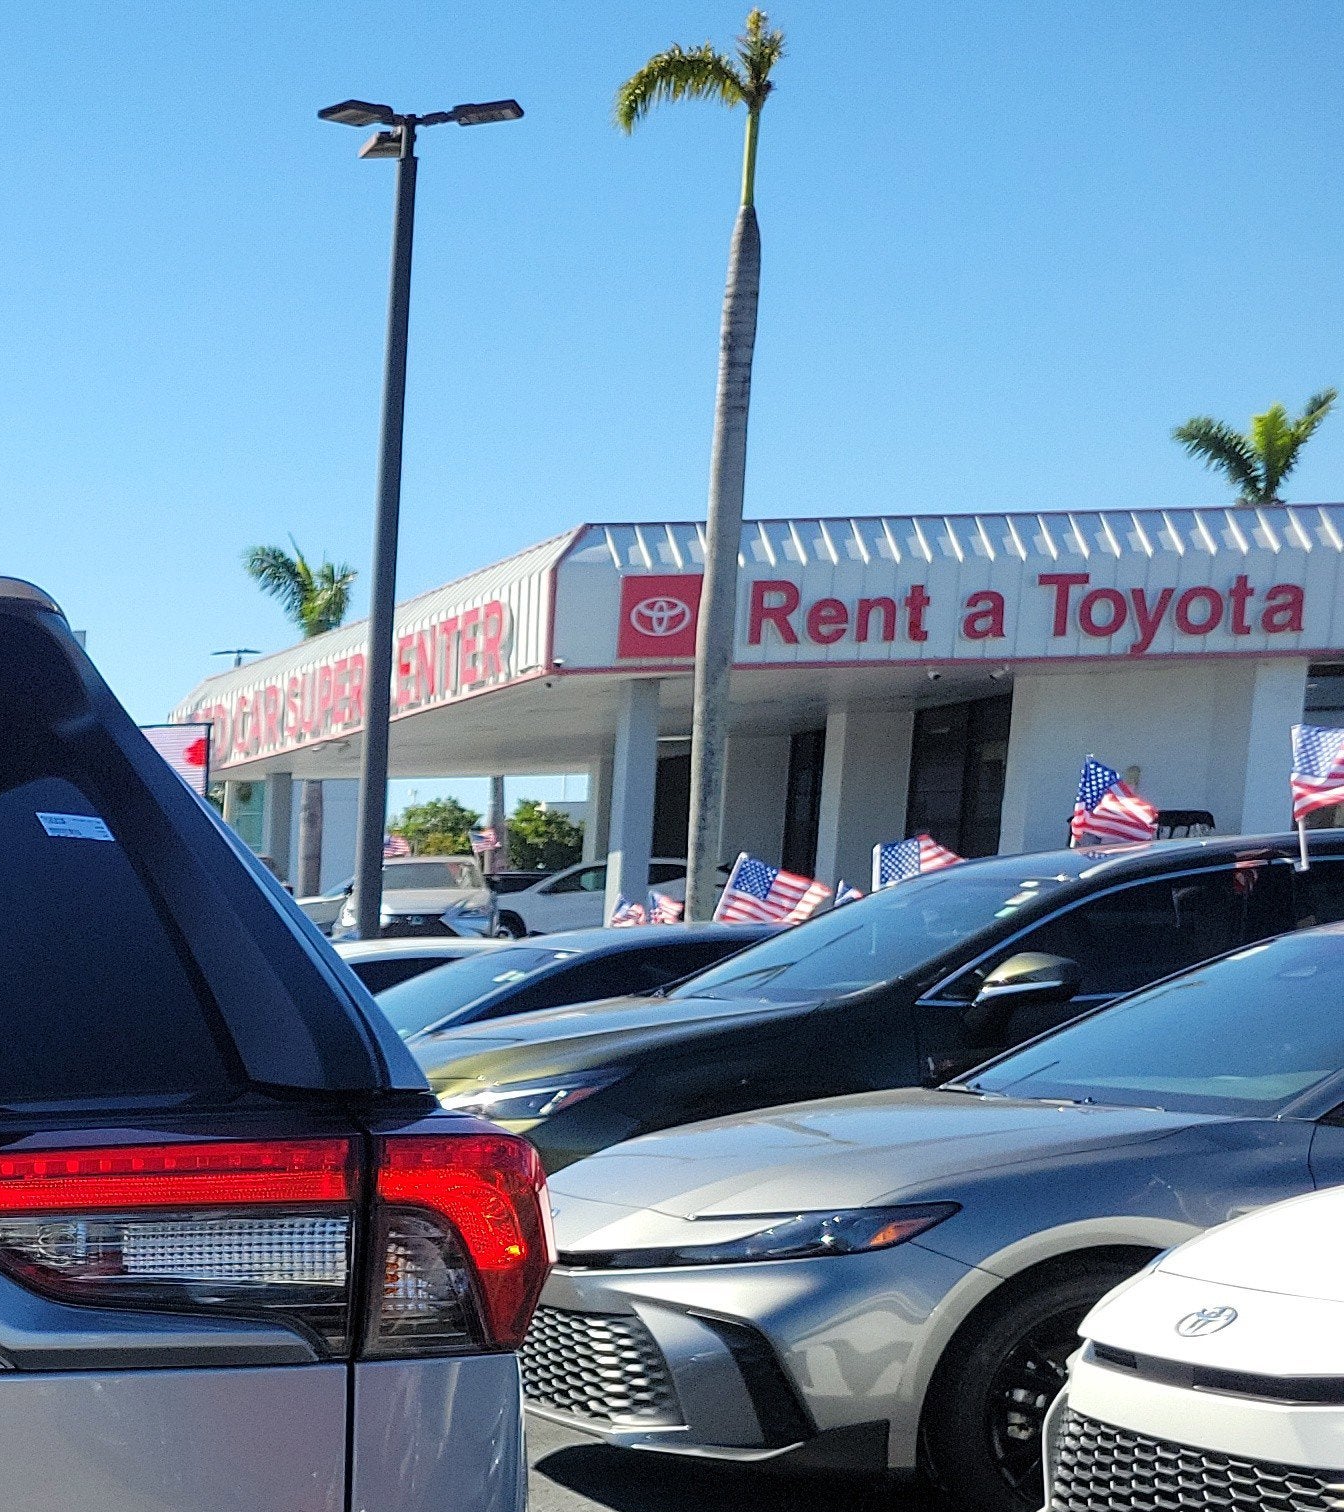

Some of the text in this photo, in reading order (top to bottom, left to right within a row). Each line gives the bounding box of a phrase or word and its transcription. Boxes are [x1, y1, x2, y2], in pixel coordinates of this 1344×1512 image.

[747, 572, 1305, 655] Rent a Toyota
[231, 684, 282, 752] CAR
[286, 652, 366, 740] SUPER
[396, 599, 506, 707] ENTER
